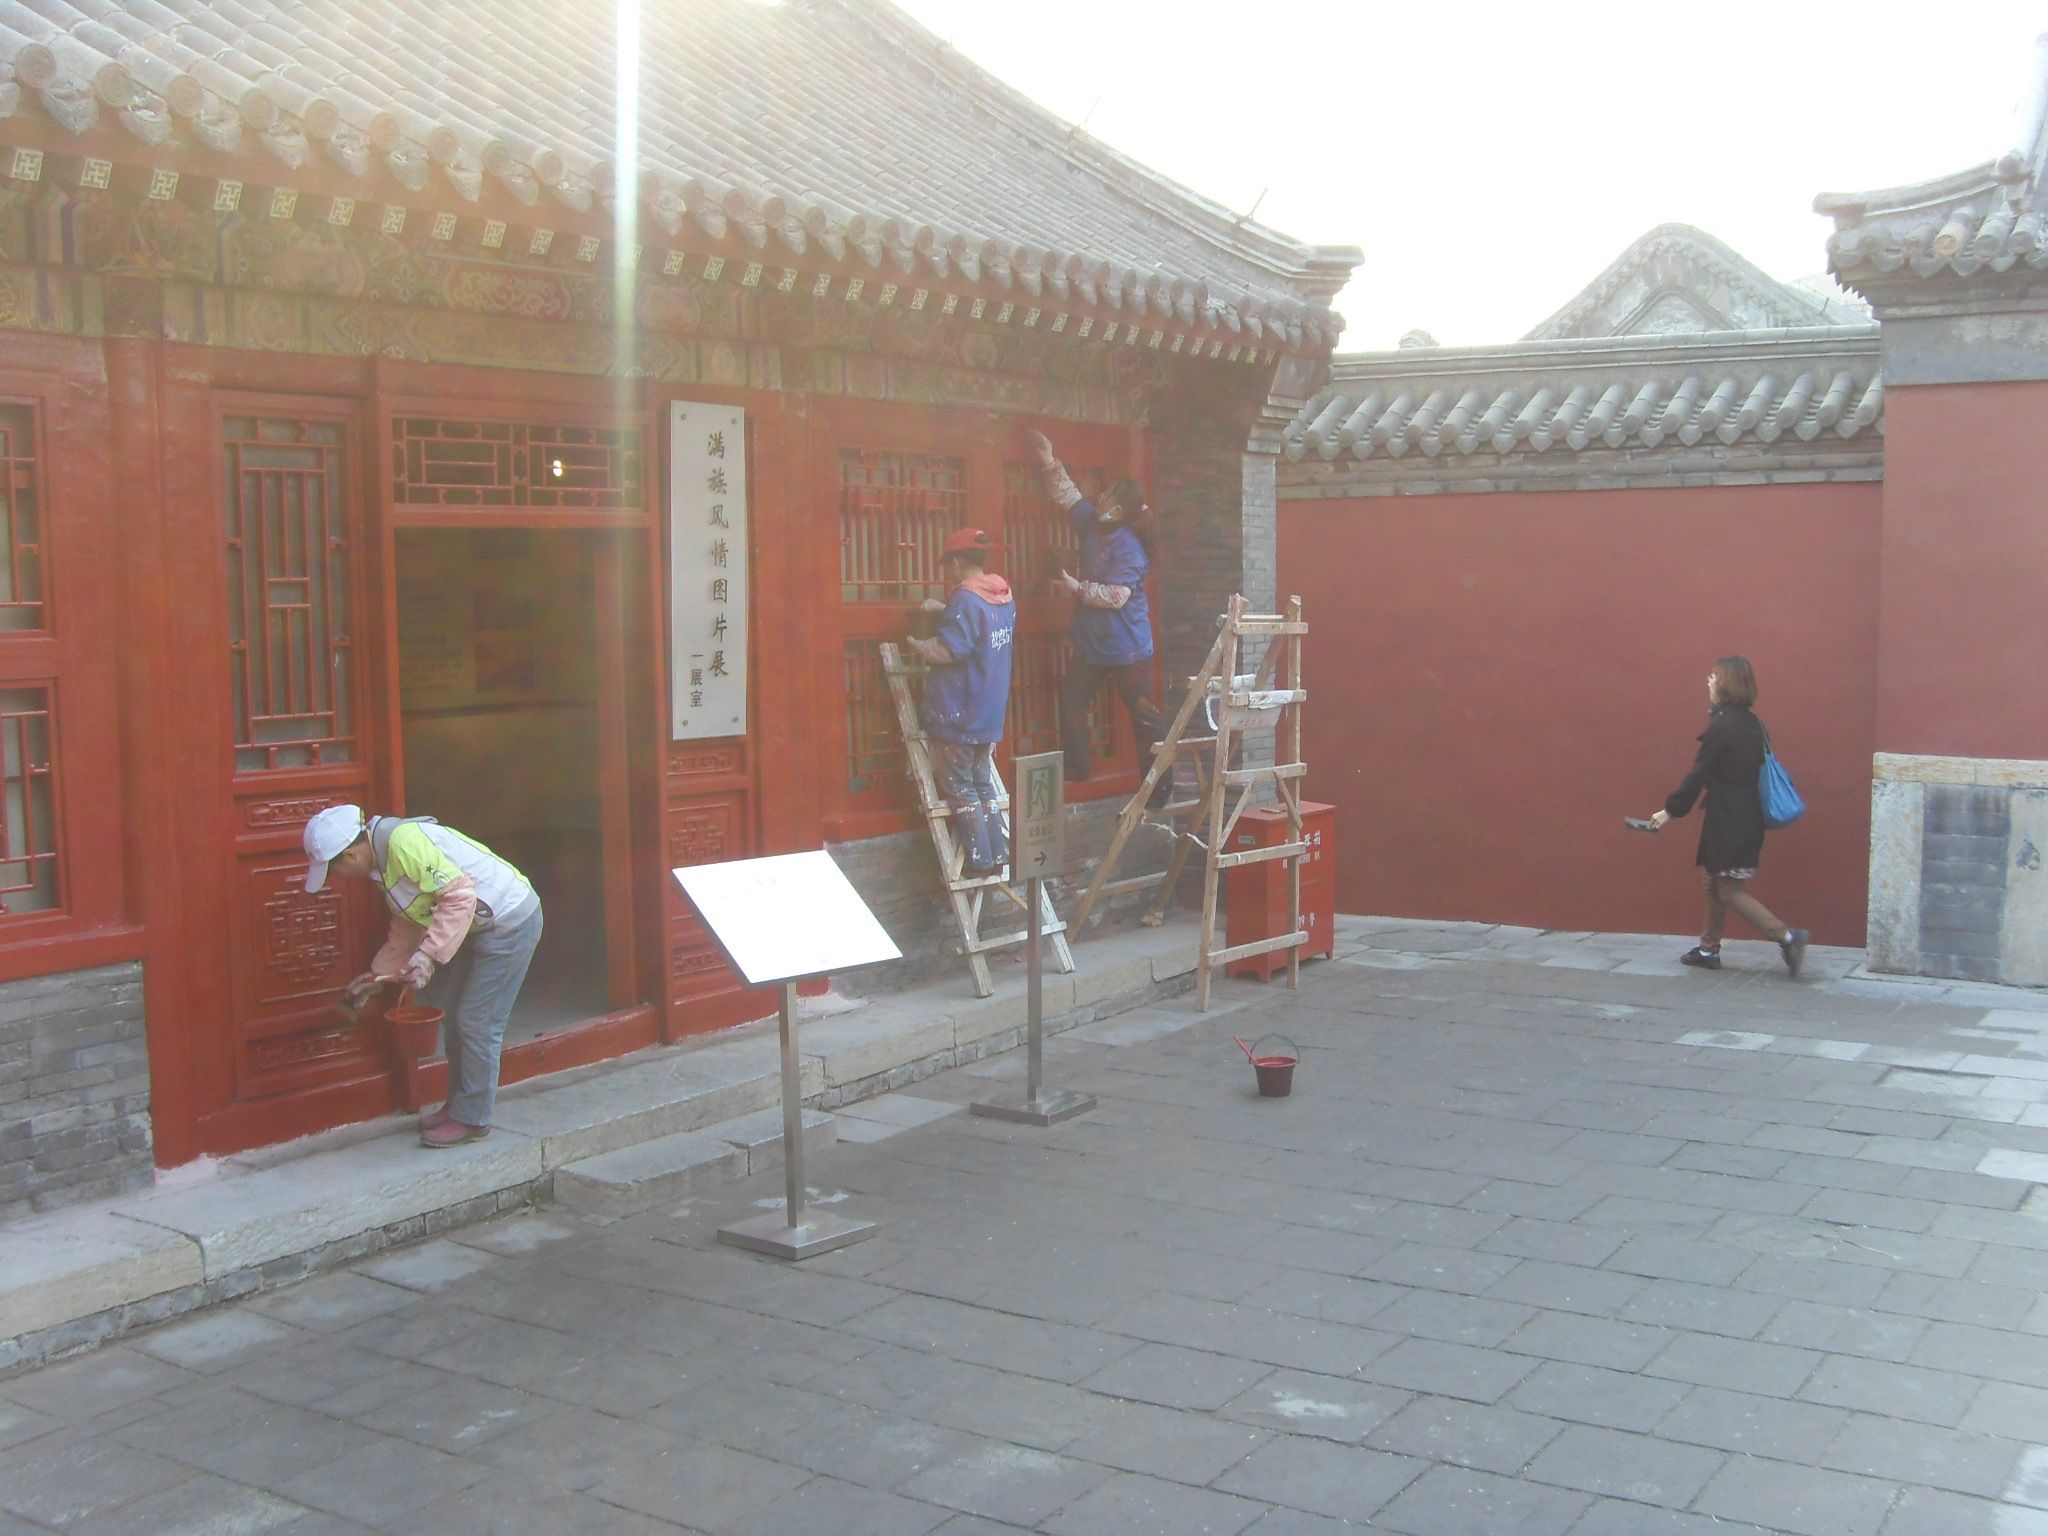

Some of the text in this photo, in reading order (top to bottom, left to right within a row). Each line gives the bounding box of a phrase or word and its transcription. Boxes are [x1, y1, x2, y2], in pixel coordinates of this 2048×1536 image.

[706, 431, 729, 678] 满族风情图片展
[689, 653, 704, 708] 一展室
